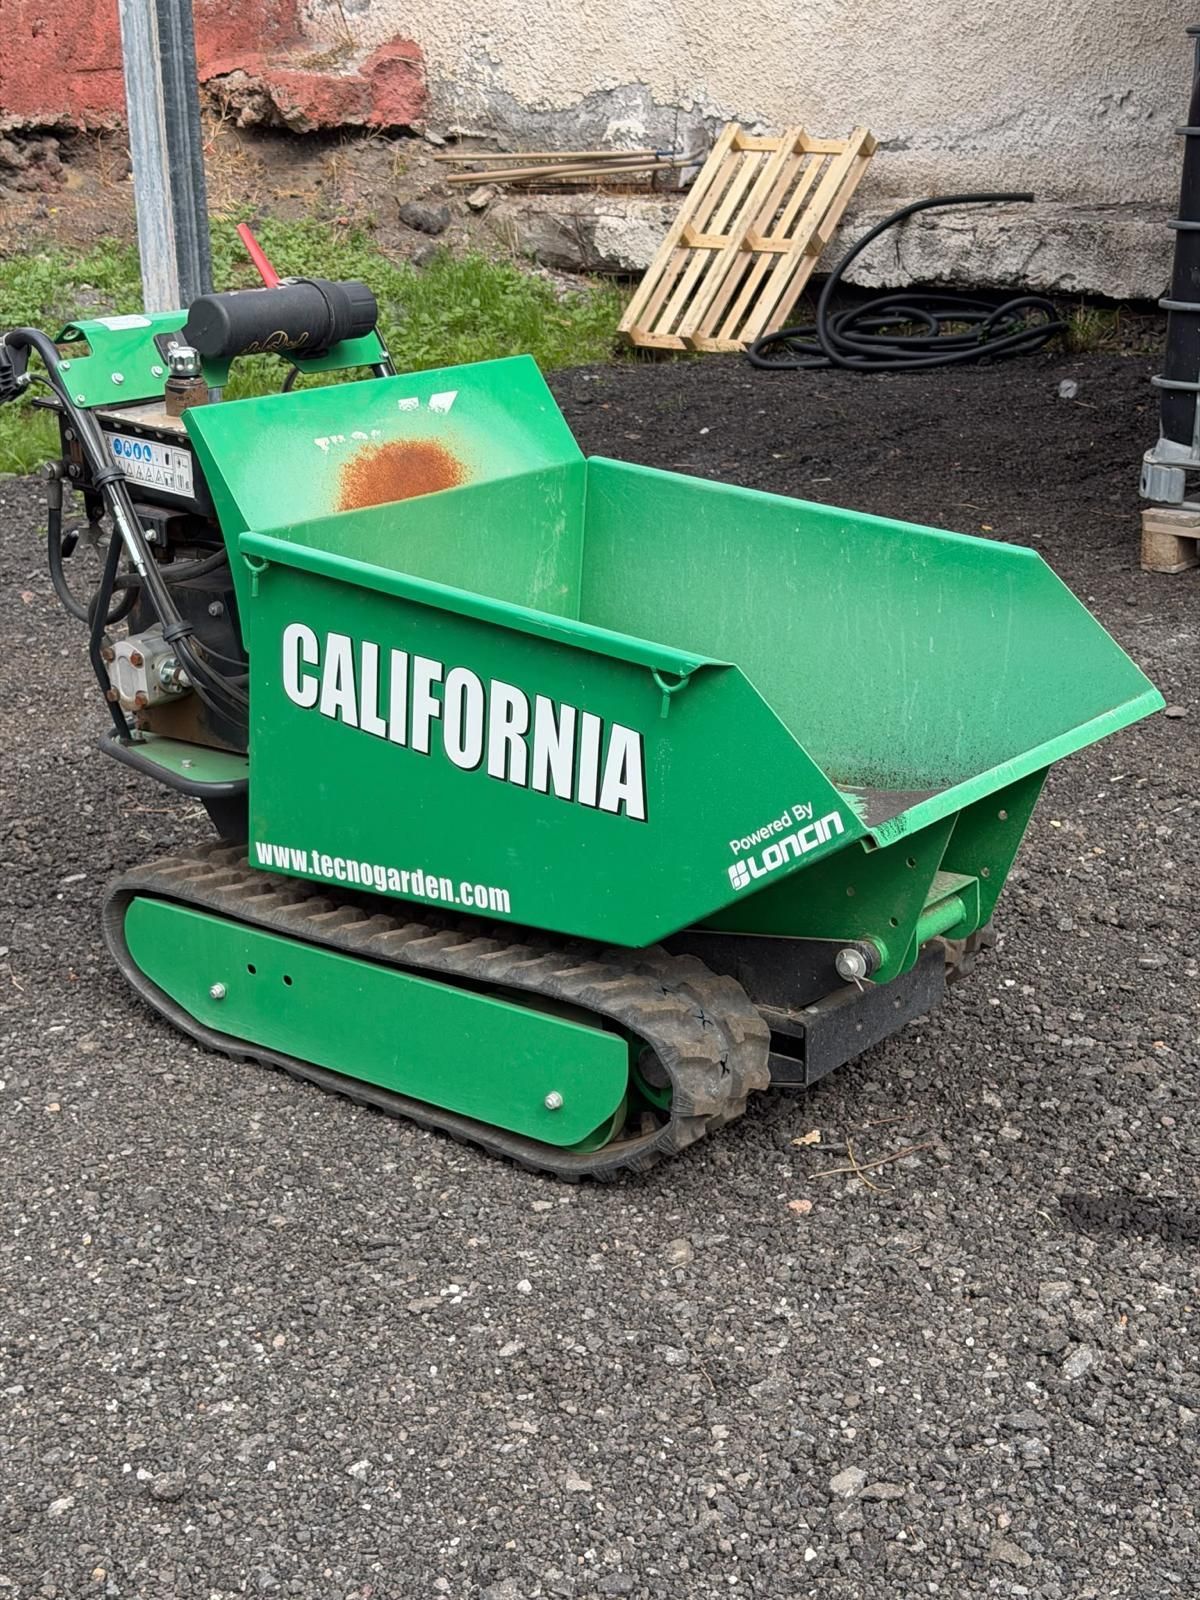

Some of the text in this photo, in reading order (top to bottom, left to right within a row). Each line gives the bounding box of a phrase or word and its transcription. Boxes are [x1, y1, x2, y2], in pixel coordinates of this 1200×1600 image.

[282, 622, 648, 823] CALIFORNIA
[729, 801, 813, 855] Powered By
[255, 841, 511, 913] www.tecnogarden.com
